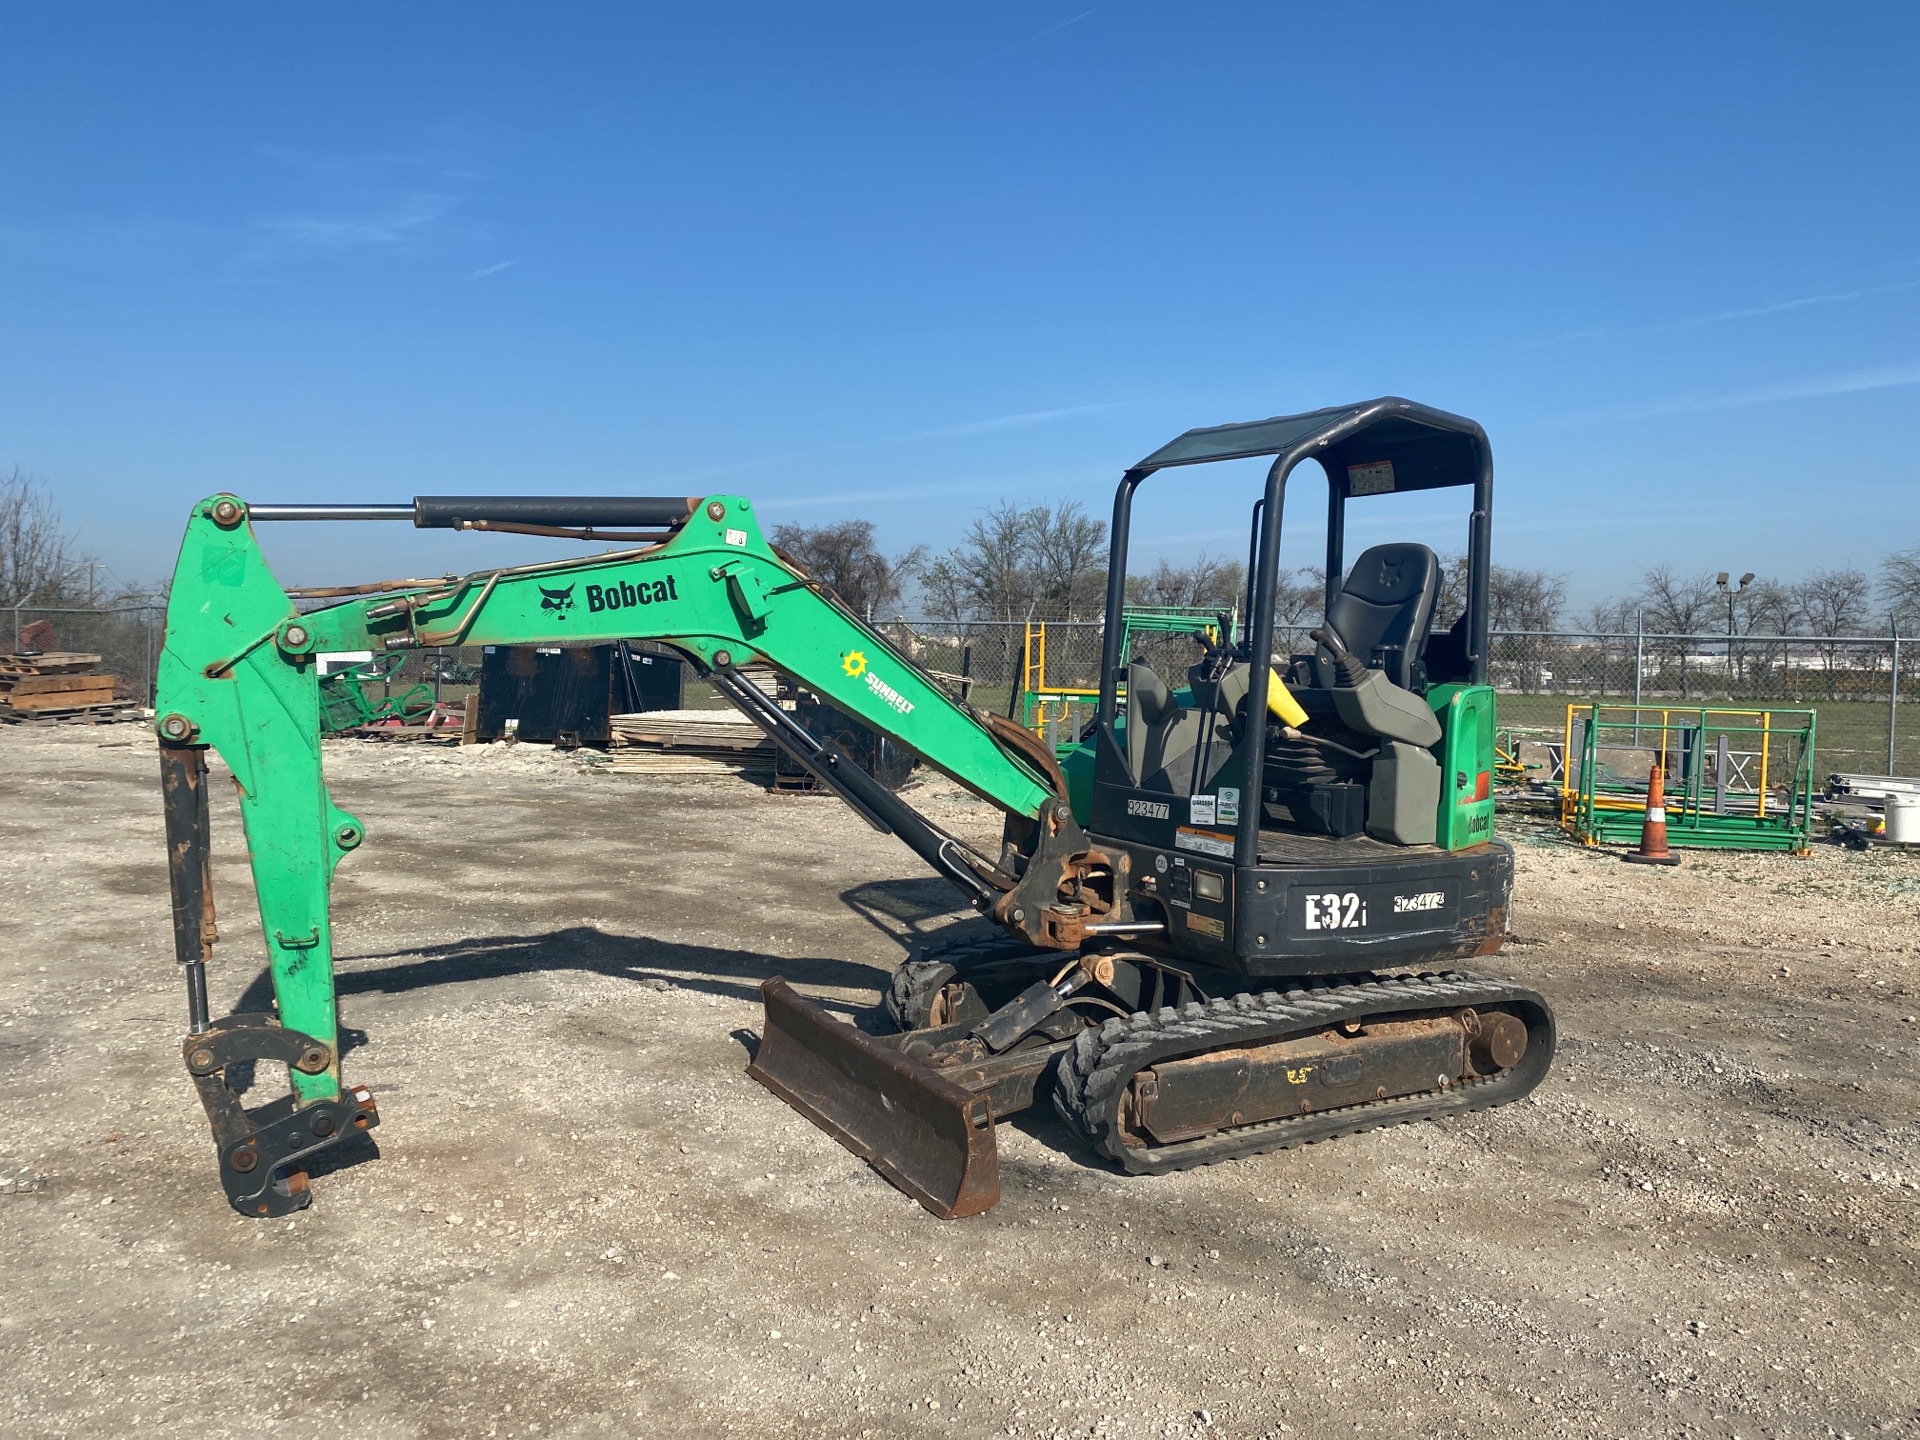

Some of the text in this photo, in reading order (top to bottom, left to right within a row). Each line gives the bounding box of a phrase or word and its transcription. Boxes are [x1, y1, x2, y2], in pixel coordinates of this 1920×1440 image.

[586, 575, 678, 612] Bobcat
[865, 672, 915, 714] SUNBELT
[868, 686, 903, 714] RENTALS
[1128, 800, 1168, 818] 923477
[1468, 812, 1489, 834] Bobcat
[1306, 893, 1367, 930] E32i
